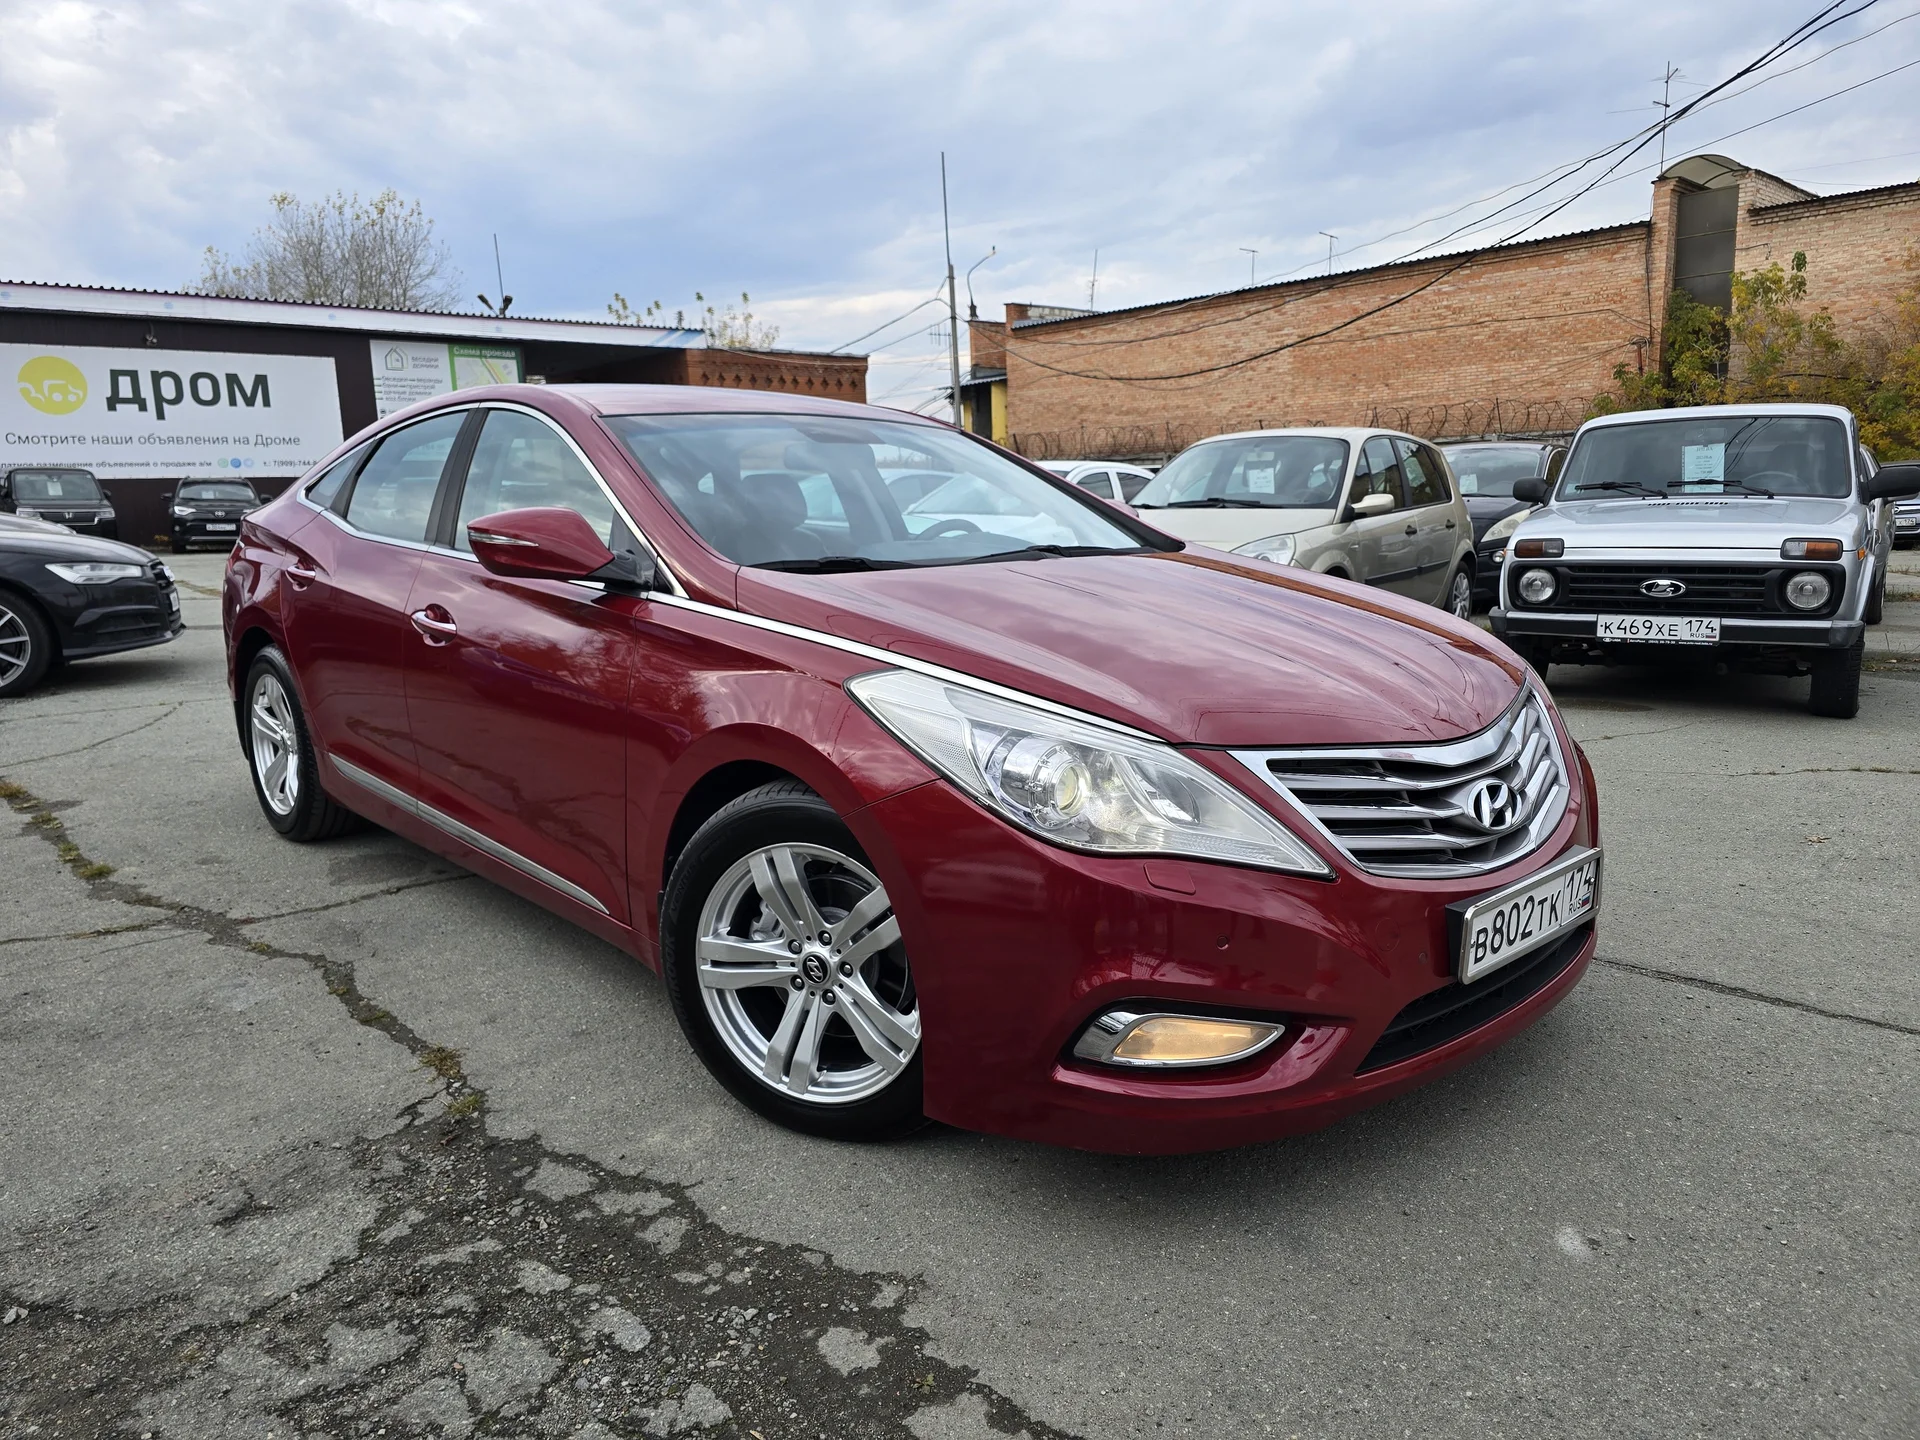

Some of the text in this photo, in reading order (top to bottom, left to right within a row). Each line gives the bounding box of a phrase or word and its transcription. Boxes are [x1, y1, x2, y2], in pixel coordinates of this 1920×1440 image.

[106, 369, 271, 420] дром
[5, 432, 301, 448] Смотрите наши объявления на Дроме
[96, 460, 151, 468] объявлений
[160, 461, 196, 469] продаже
[1604, 618, 1714, 636] К469ХЕ 174
[1473, 862, 1594, 965] В802ТК 174
[1568, 898, 1582, 916] RUS
